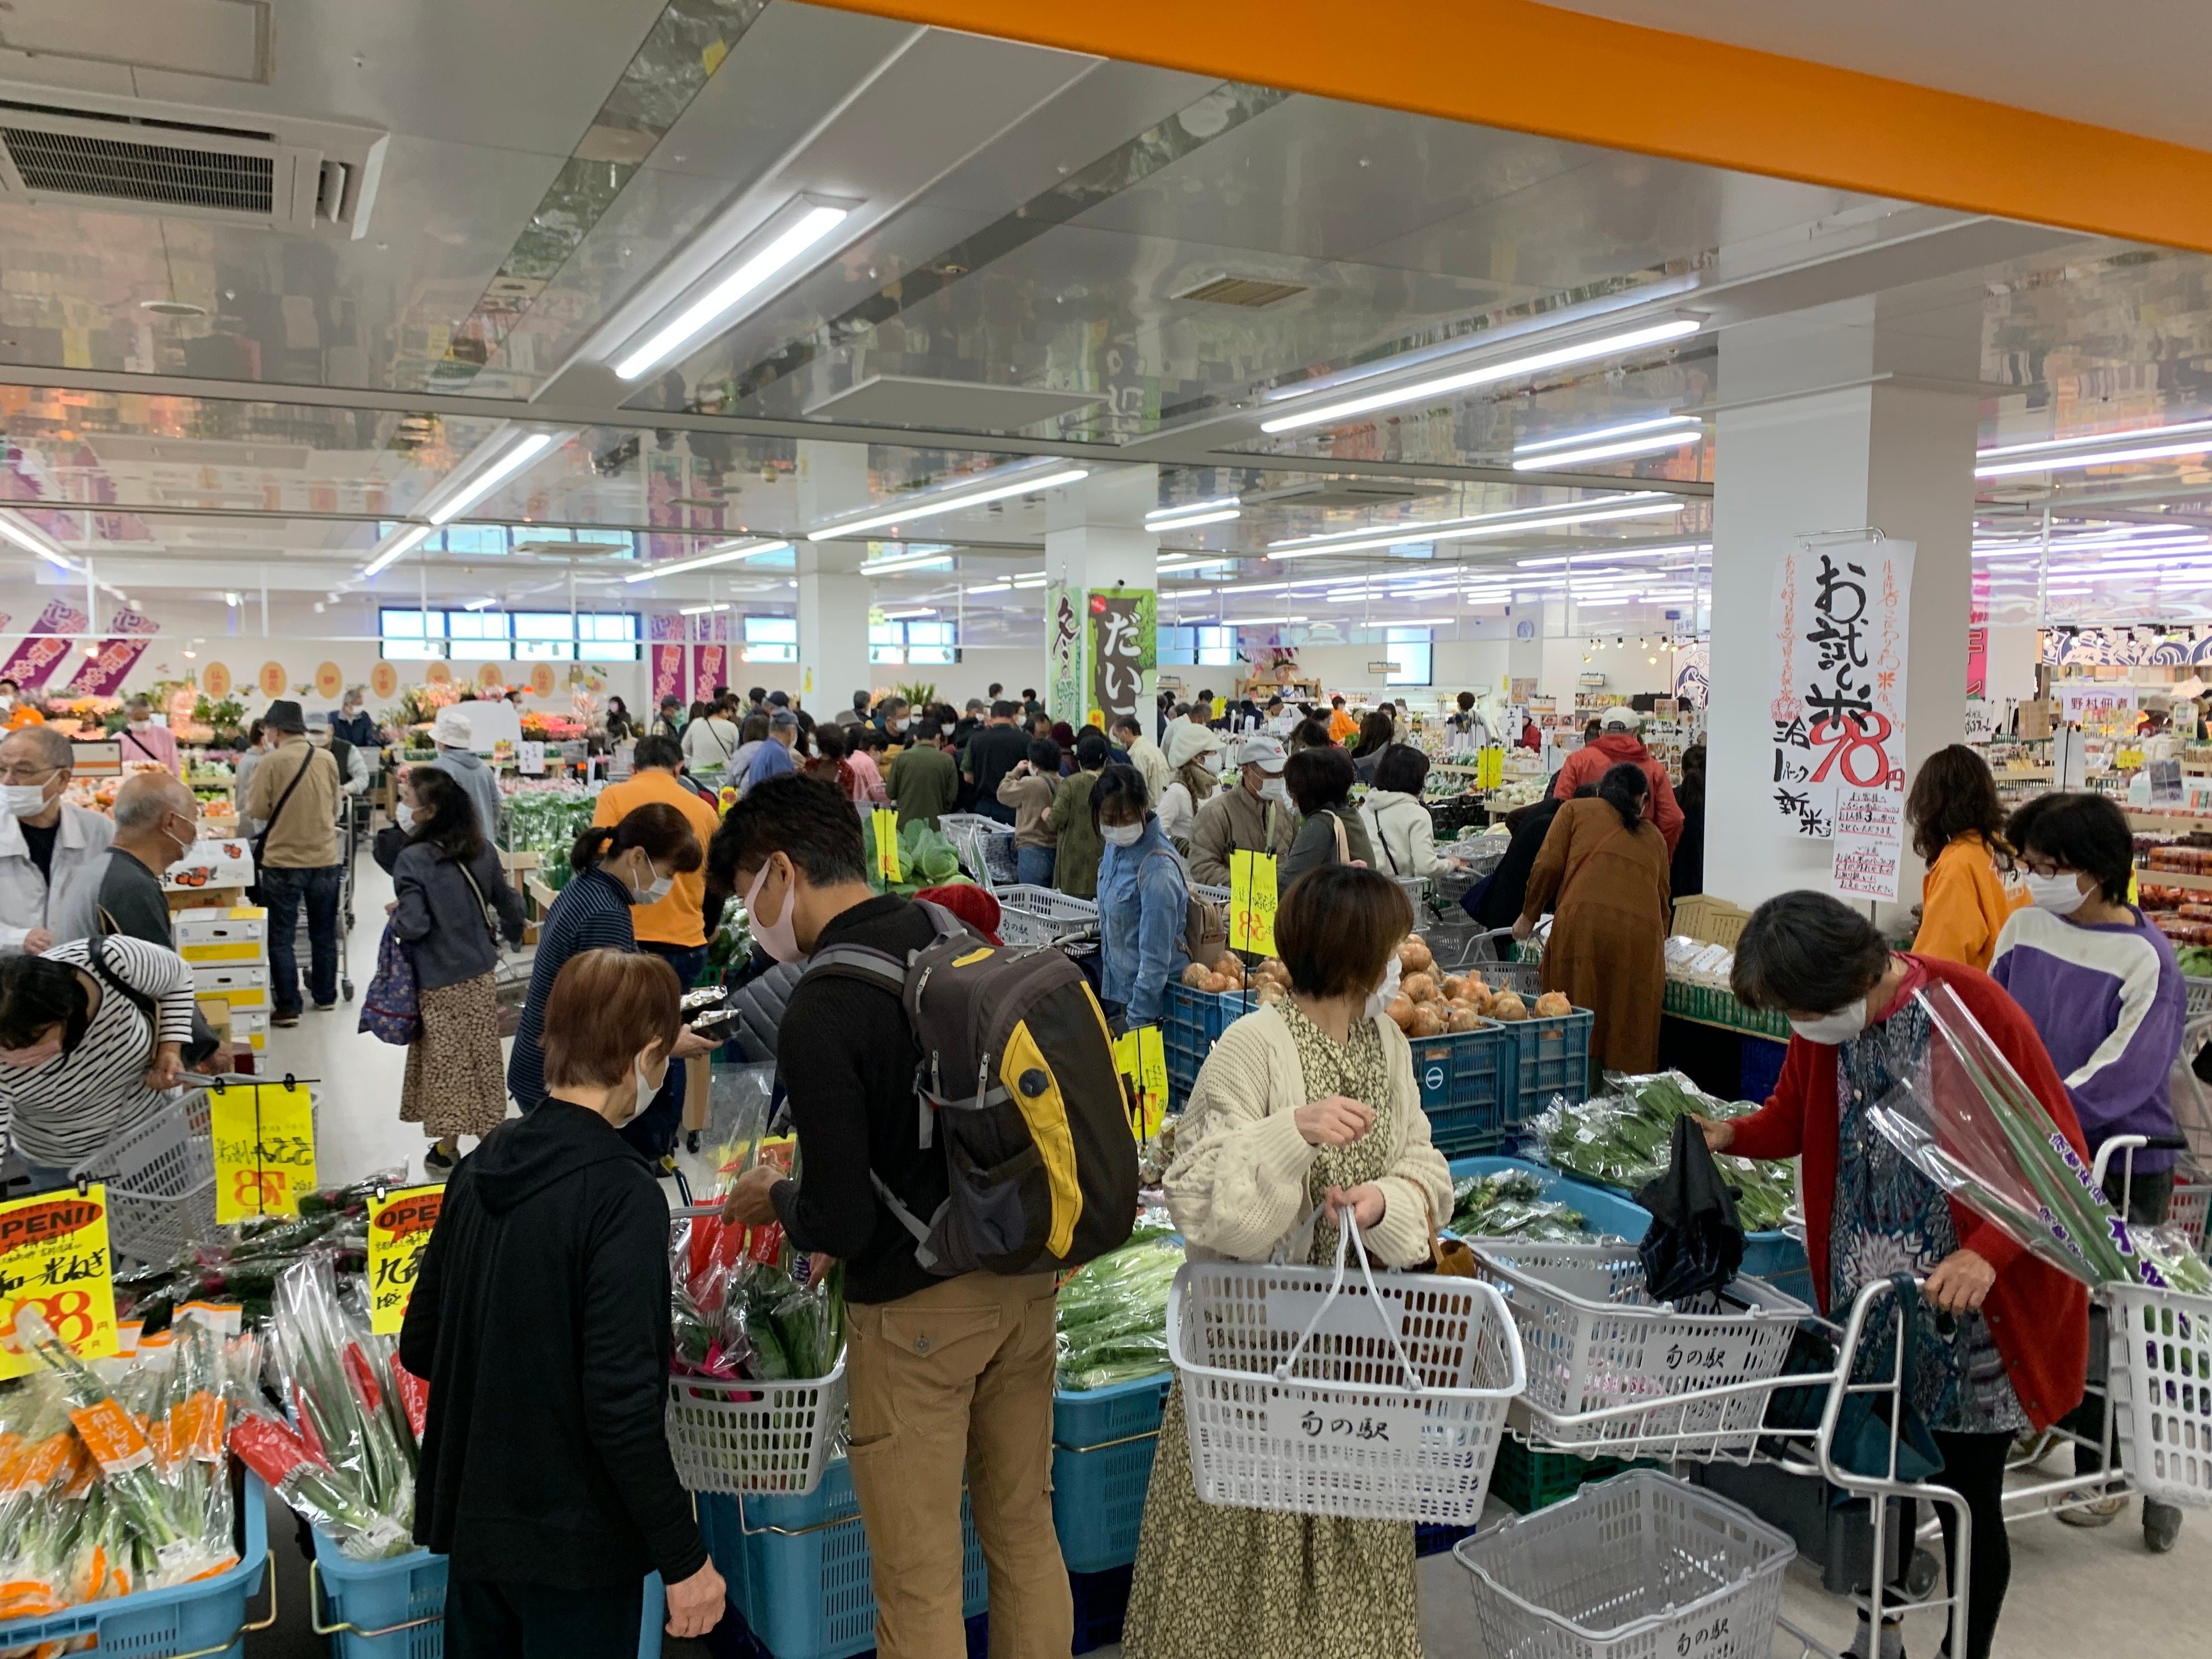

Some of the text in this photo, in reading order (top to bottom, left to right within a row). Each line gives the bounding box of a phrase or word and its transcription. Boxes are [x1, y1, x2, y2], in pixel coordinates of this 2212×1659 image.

[1805, 555, 1872, 731] お試し米
[1809, 711, 1892, 787] 98
[1885, 769, 1905, 792] 円
[1666, 1344, 1726, 1370] 旬の駅
[1301, 1411, 1390, 1441] 旬の駅
[1677, 1618, 1729, 1657] 旬の駅
